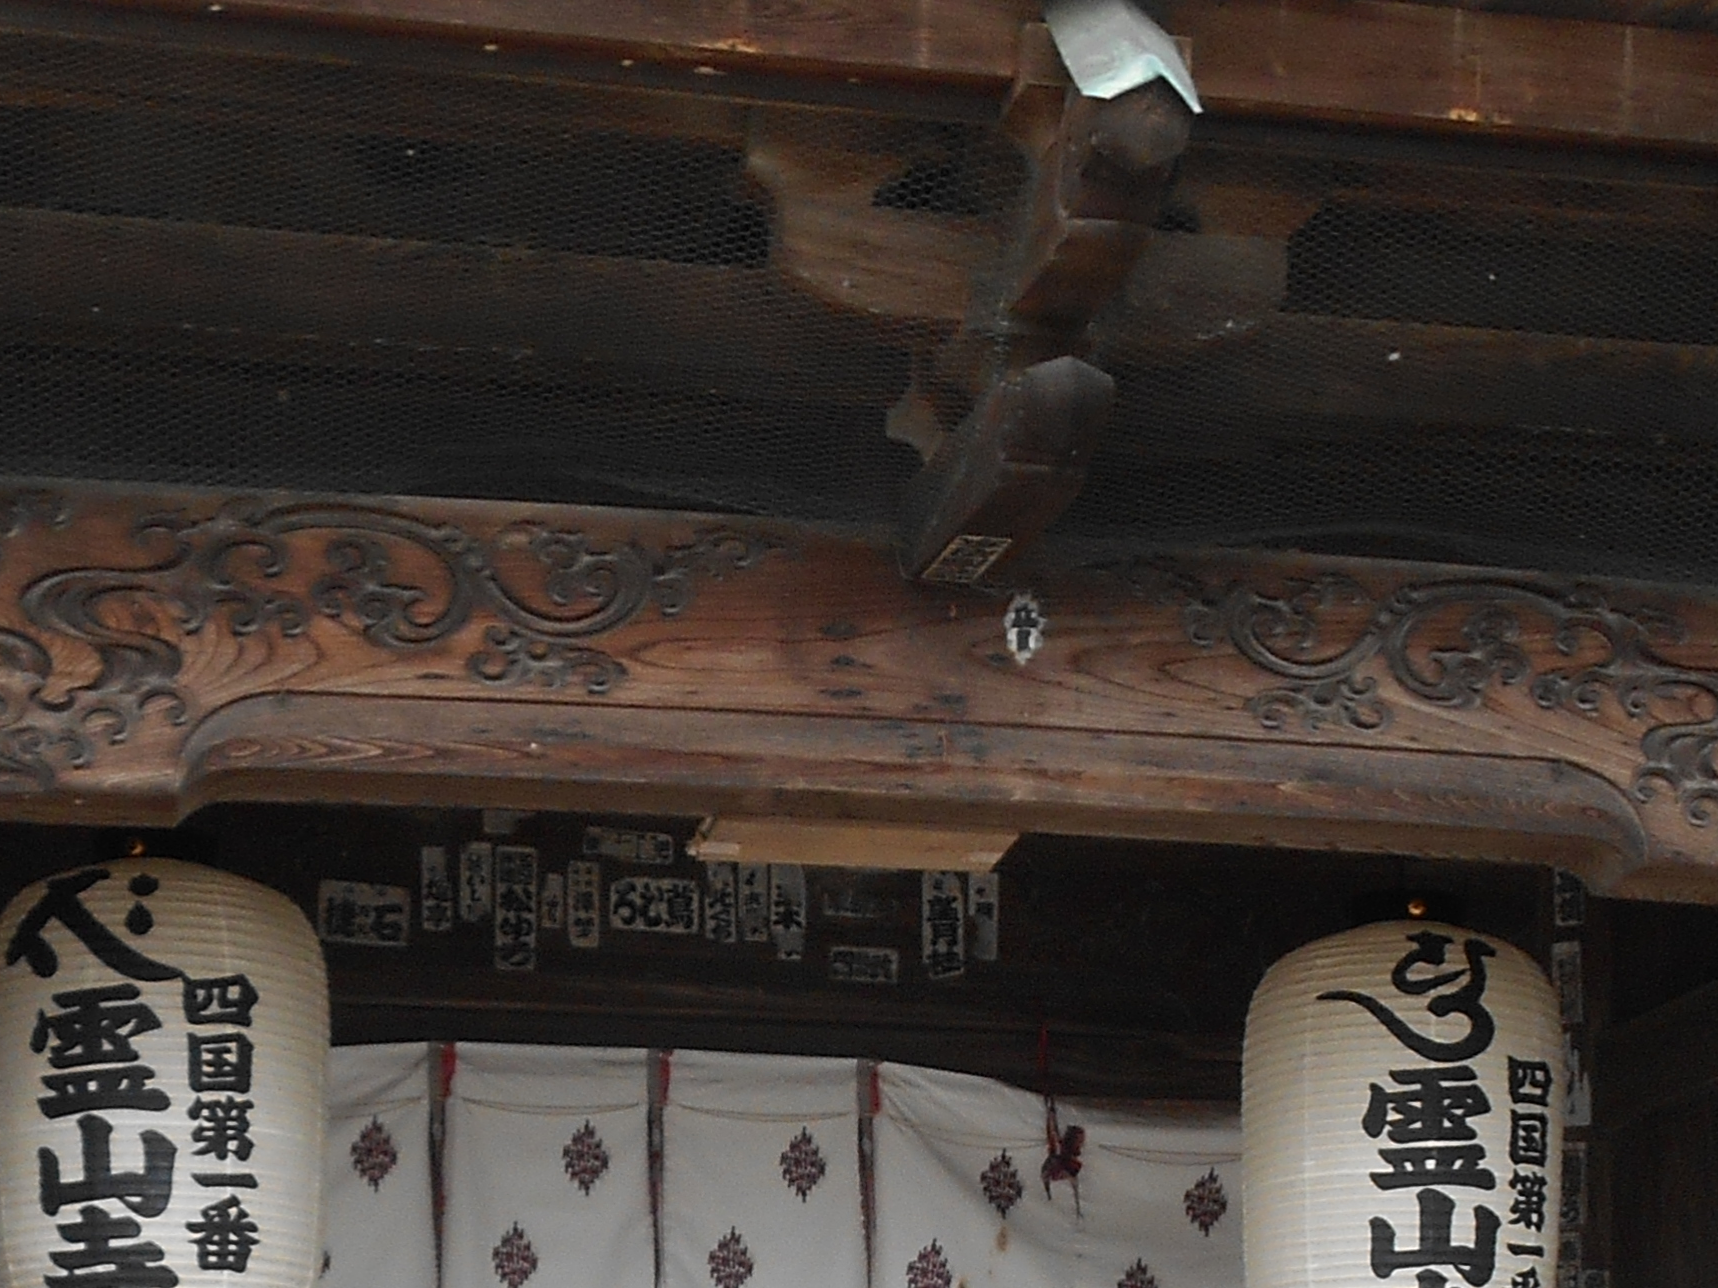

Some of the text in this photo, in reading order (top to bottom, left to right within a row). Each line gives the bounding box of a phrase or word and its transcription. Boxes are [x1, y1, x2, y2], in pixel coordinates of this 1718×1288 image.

[183, 972, 260, 1273] 四国第一番
